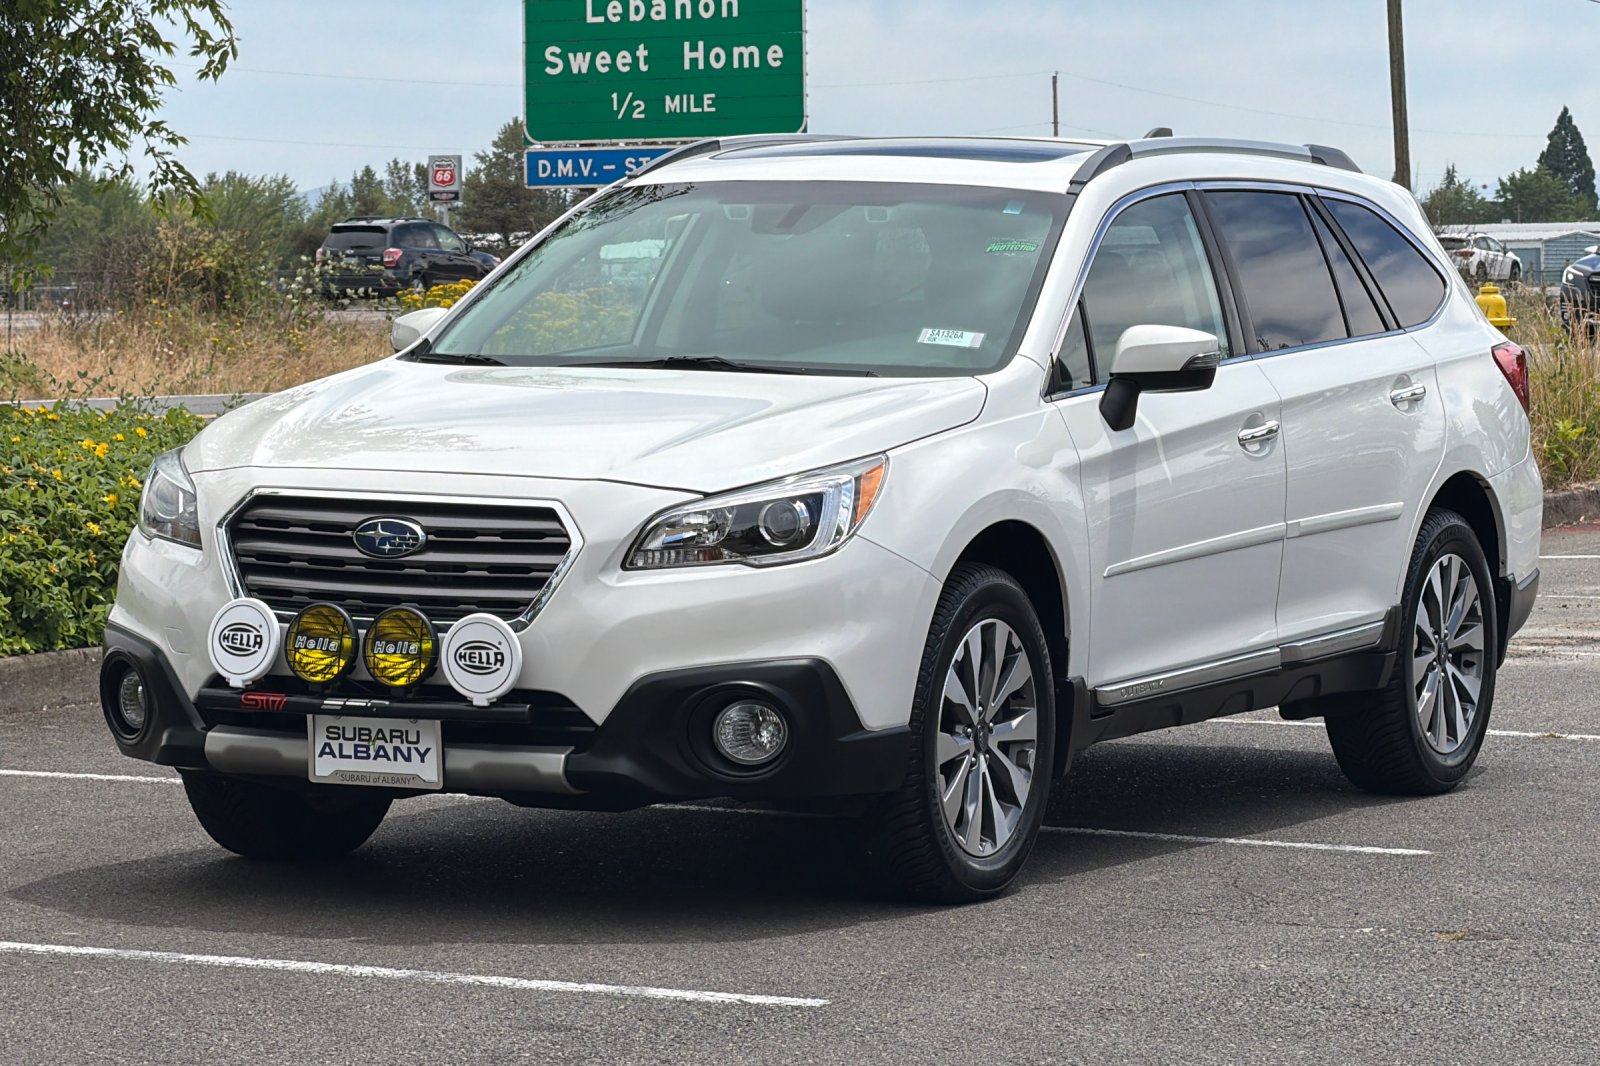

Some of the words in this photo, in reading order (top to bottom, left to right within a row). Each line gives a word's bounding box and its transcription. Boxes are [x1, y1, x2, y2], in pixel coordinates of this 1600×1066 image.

[586, 0, 739, 23] Lebanon
[544, 44, 649, 75] Sweet
[683, 41, 784, 70] Home
[611, 92, 645, 119] 1/2
[665, 93, 716, 113] MILE
[435, 170, 452, 182] 66
[538, 158, 598, 177] D.M.V.
[929, 329, 964, 340] SA1326A
[222, 632, 263, 650] HELLA
[295, 635, 339, 652] Hella
[373, 640, 418, 655] Hella
[458, 651, 505, 668] HELLA
[325, 725, 421, 745] SUBARU
[317, 742, 432, 763] ALBANY
[340, 773, 371, 783] SUBARU
[372, 776, 381, 784] of
[381, 776, 412, 785] ALBANY
